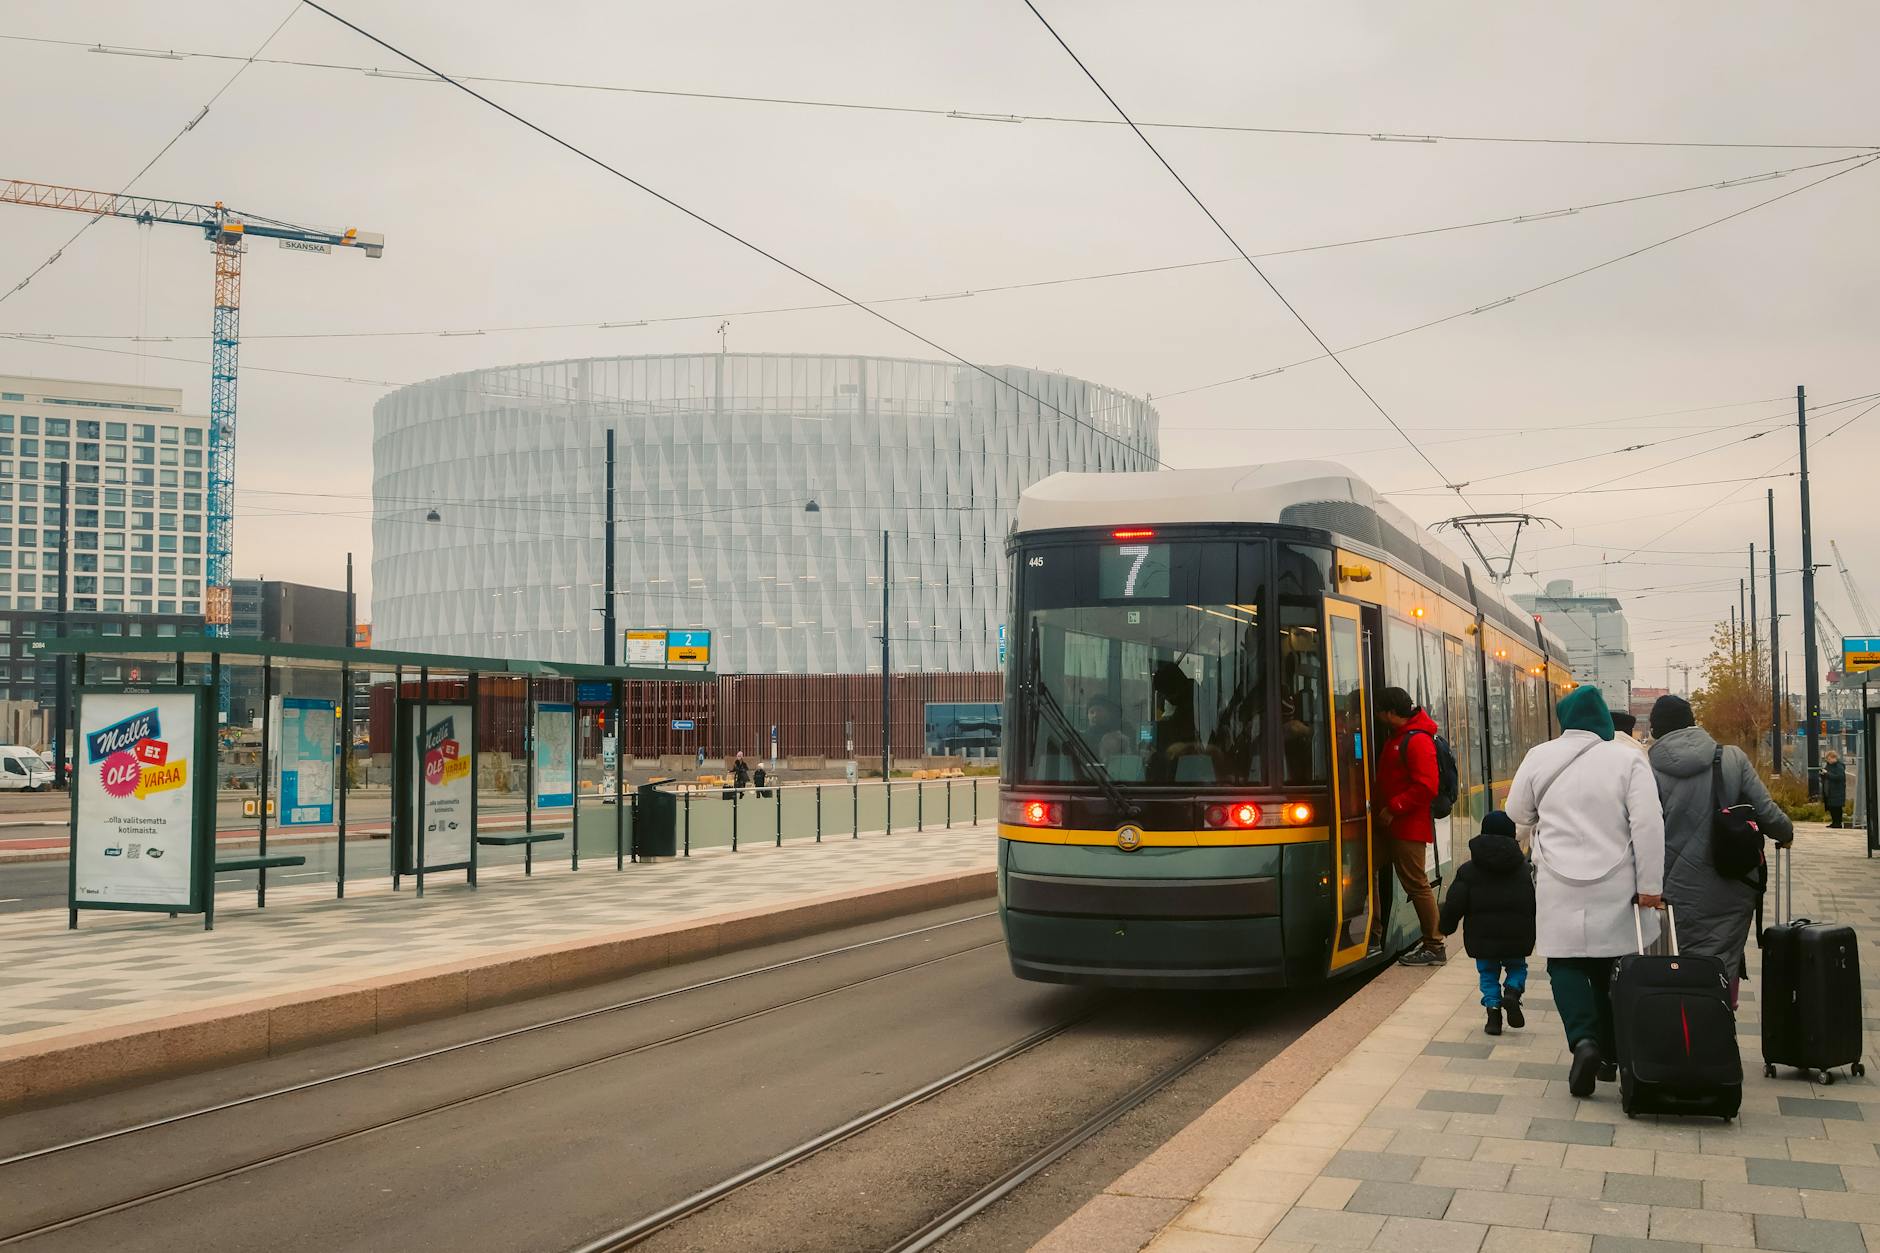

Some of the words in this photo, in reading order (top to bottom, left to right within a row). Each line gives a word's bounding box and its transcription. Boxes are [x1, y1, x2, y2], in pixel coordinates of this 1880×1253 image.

[285, 241, 325, 252] SKANSKA
[1029, 557, 1044, 567] 445
[1120, 546, 1149, 596] 7
[685, 633, 693, 646] 2
[97, 716, 151, 754] Meillä
[144, 745, 161, 760] EI
[446, 744, 456, 755] EI
[107, 763, 137, 785] OLE
[427, 759, 443, 777] OLE
[143, 767, 181, 788] VARAA
[122, 816, 167, 825] valitsematta
